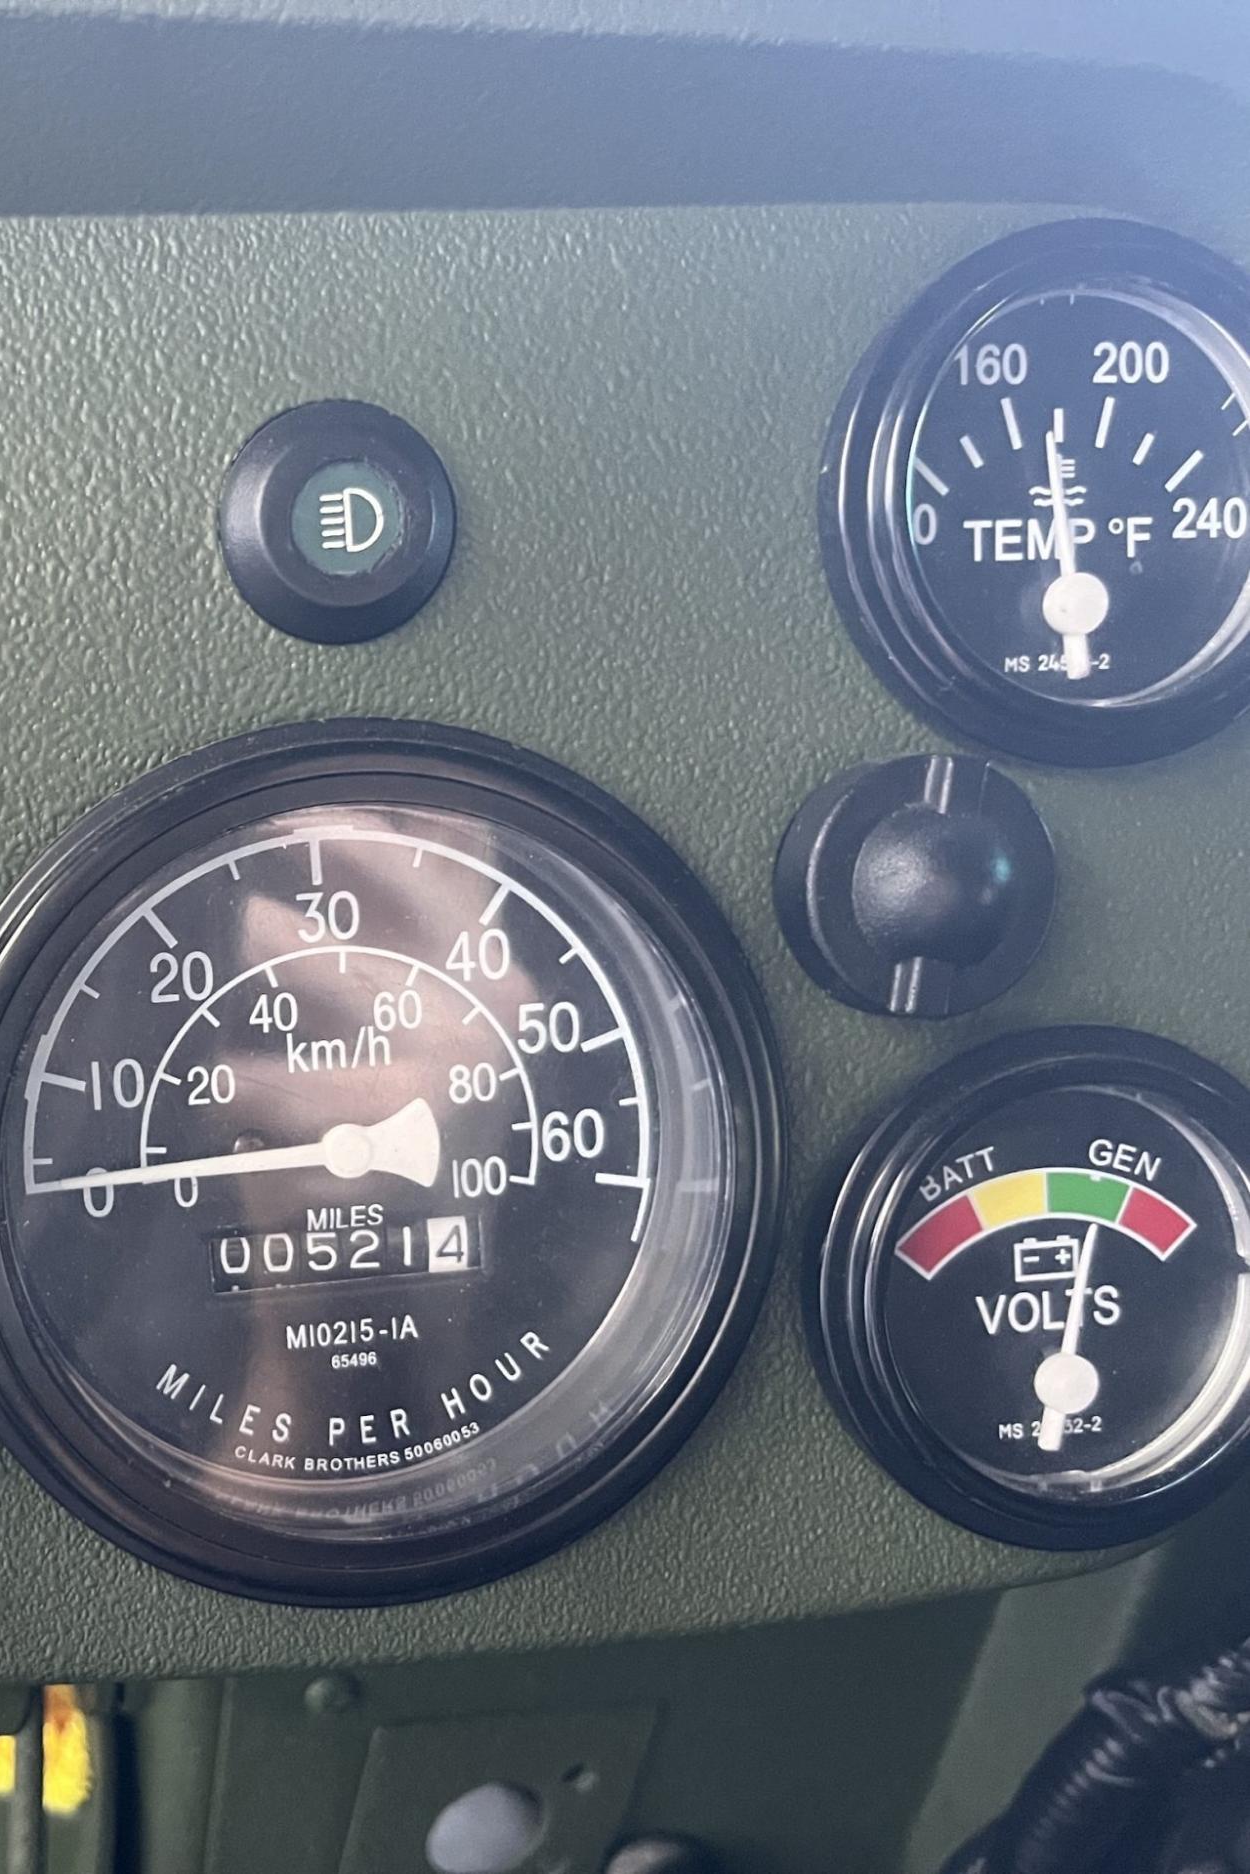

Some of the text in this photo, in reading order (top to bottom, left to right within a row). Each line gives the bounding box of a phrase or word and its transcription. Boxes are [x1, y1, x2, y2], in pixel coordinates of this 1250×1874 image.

[954, 344, 1028, 385] 160
[1093, 342, 1169, 384] 200
[913, 504, 938, 545] 0
[1172, 496, 1248, 539] 240
[963, 520, 1095, 562] TEMP
[1004, 655, 1030, 672] MS
[296, 890, 359, 942] 30
[445, 927, 510, 981] 40
[150, 951, 213, 1004] 20
[249, 992, 297, 1034] 40
[373, 988, 422, 1032] 60
[517, 1002, 579, 1054] 50
[286, 1026, 390, 1074] km/h
[91, 1057, 144, 1111] 10
[187, 1064, 235, 1106] 20
[449, 1062, 496, 1105] 80
[541, 1109, 604, 1161] 60
[453, 1158, 506, 1199] 100
[918, 1147, 996, 1202] BATT
[1089, 1139, 1162, 1181] GEN
[83, 1167, 114, 1218] 0
[174, 1167, 198, 1207] 0
[307, 1203, 384, 1231] MILES
[331, 1351, 377, 1369] 65496
[156, 1330, 551, 1446] MILES PER HOUR
[235, 1422, 480, 1472] CLARK BROTHERS 50060053
[998, 1423, 1025, 1440] MS
